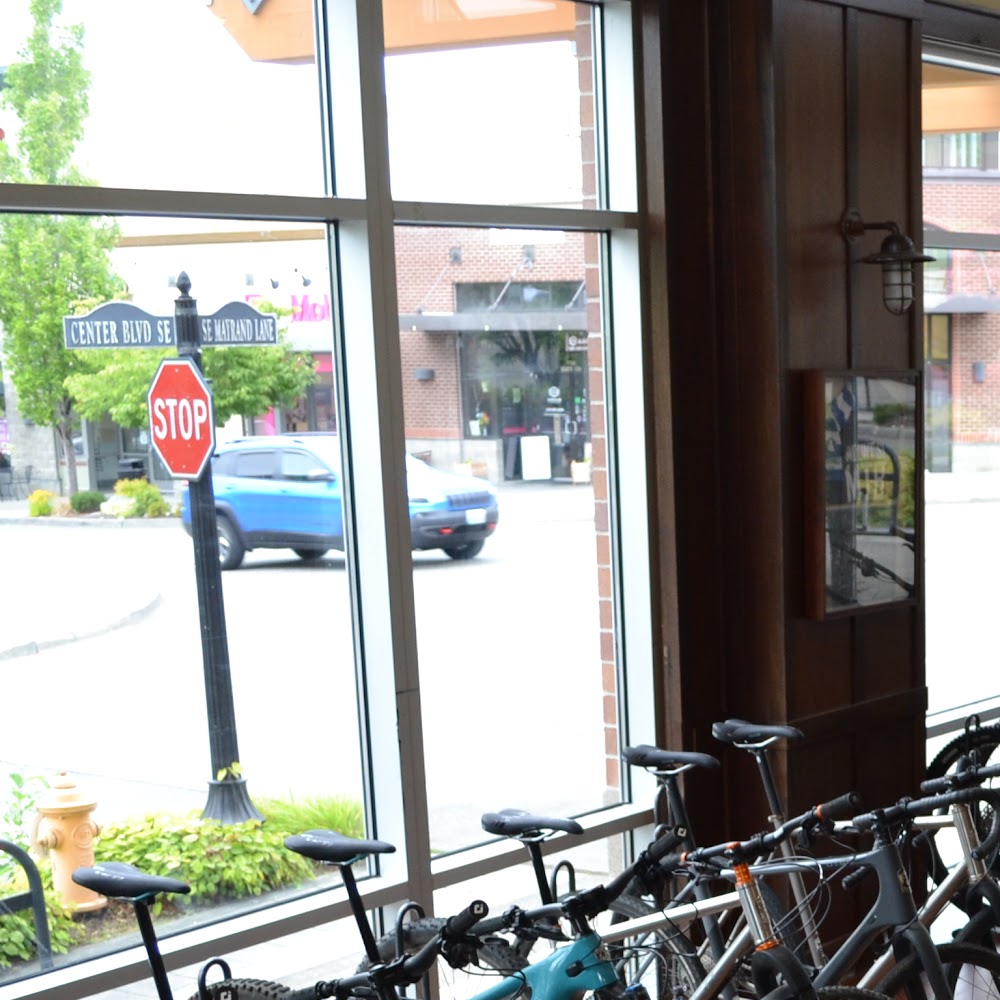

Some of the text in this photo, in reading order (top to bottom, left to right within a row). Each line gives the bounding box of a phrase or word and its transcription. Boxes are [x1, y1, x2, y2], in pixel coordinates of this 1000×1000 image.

[71, 320, 172, 344] CENTER BLVD SE
[202, 318, 213, 342] SE
[254, 318, 275, 342] LANE
[154, 397, 208, 441] STOP
